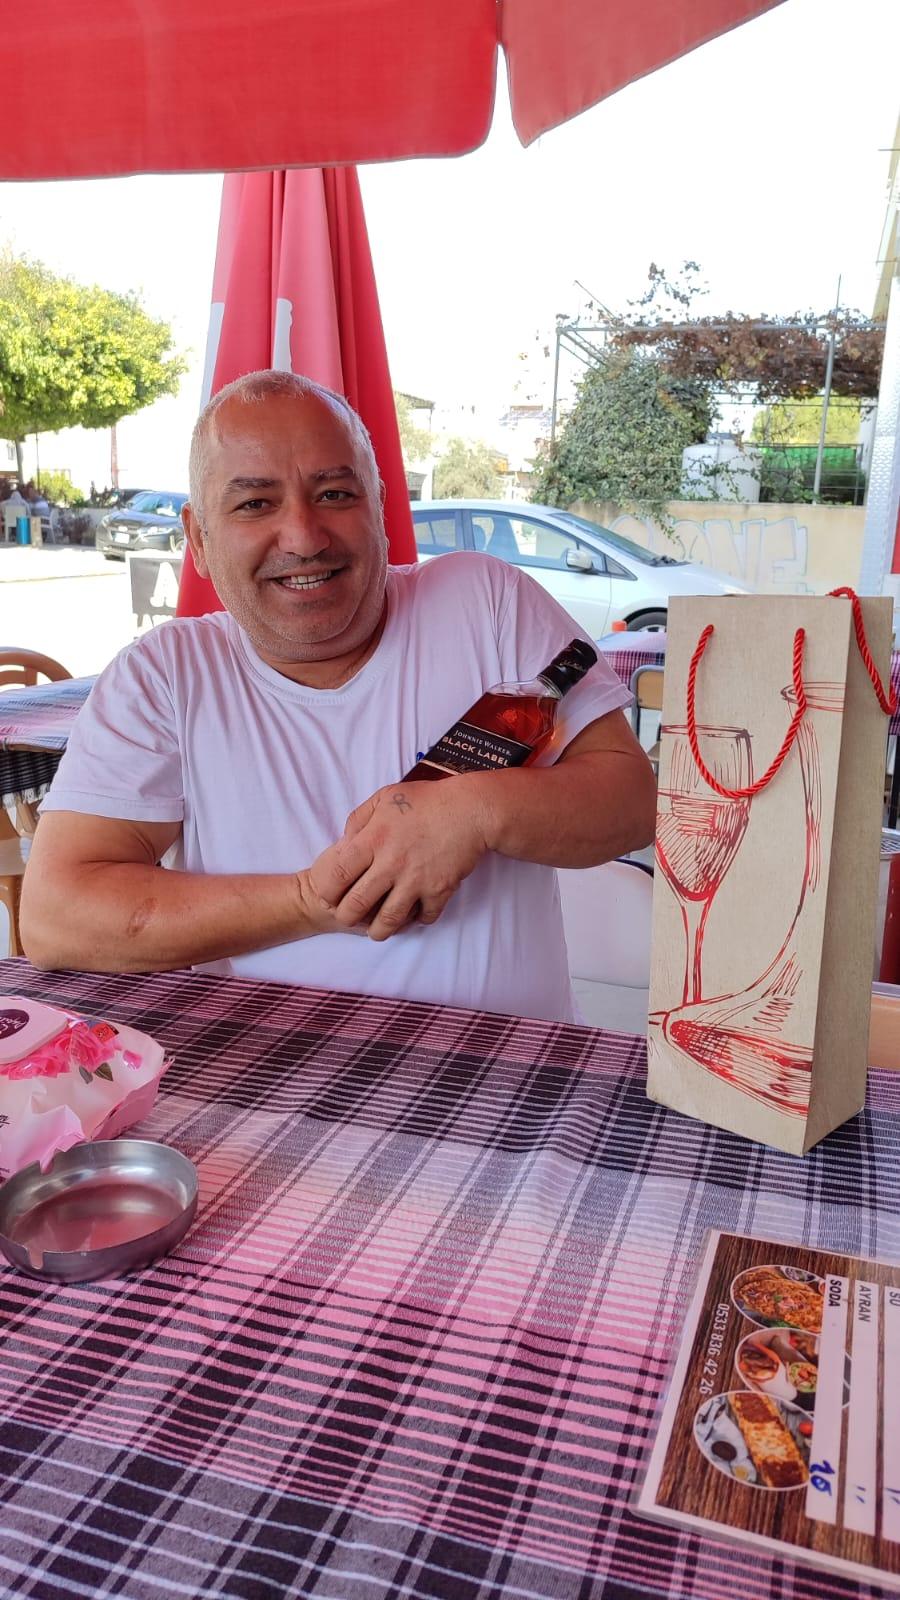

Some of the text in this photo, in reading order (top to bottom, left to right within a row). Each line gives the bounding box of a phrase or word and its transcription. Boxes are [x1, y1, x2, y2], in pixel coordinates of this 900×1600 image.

[442, 736, 476, 753] BLACK
[477, 749, 509, 766] LABEL
[453, 730, 512, 756] JOHNNIE WALKER
[828, 1279, 842, 1307] SODA
[858, 1284, 872, 1323] AYRAN
[699, 1303, 730, 1396] 0533 836 42 26
